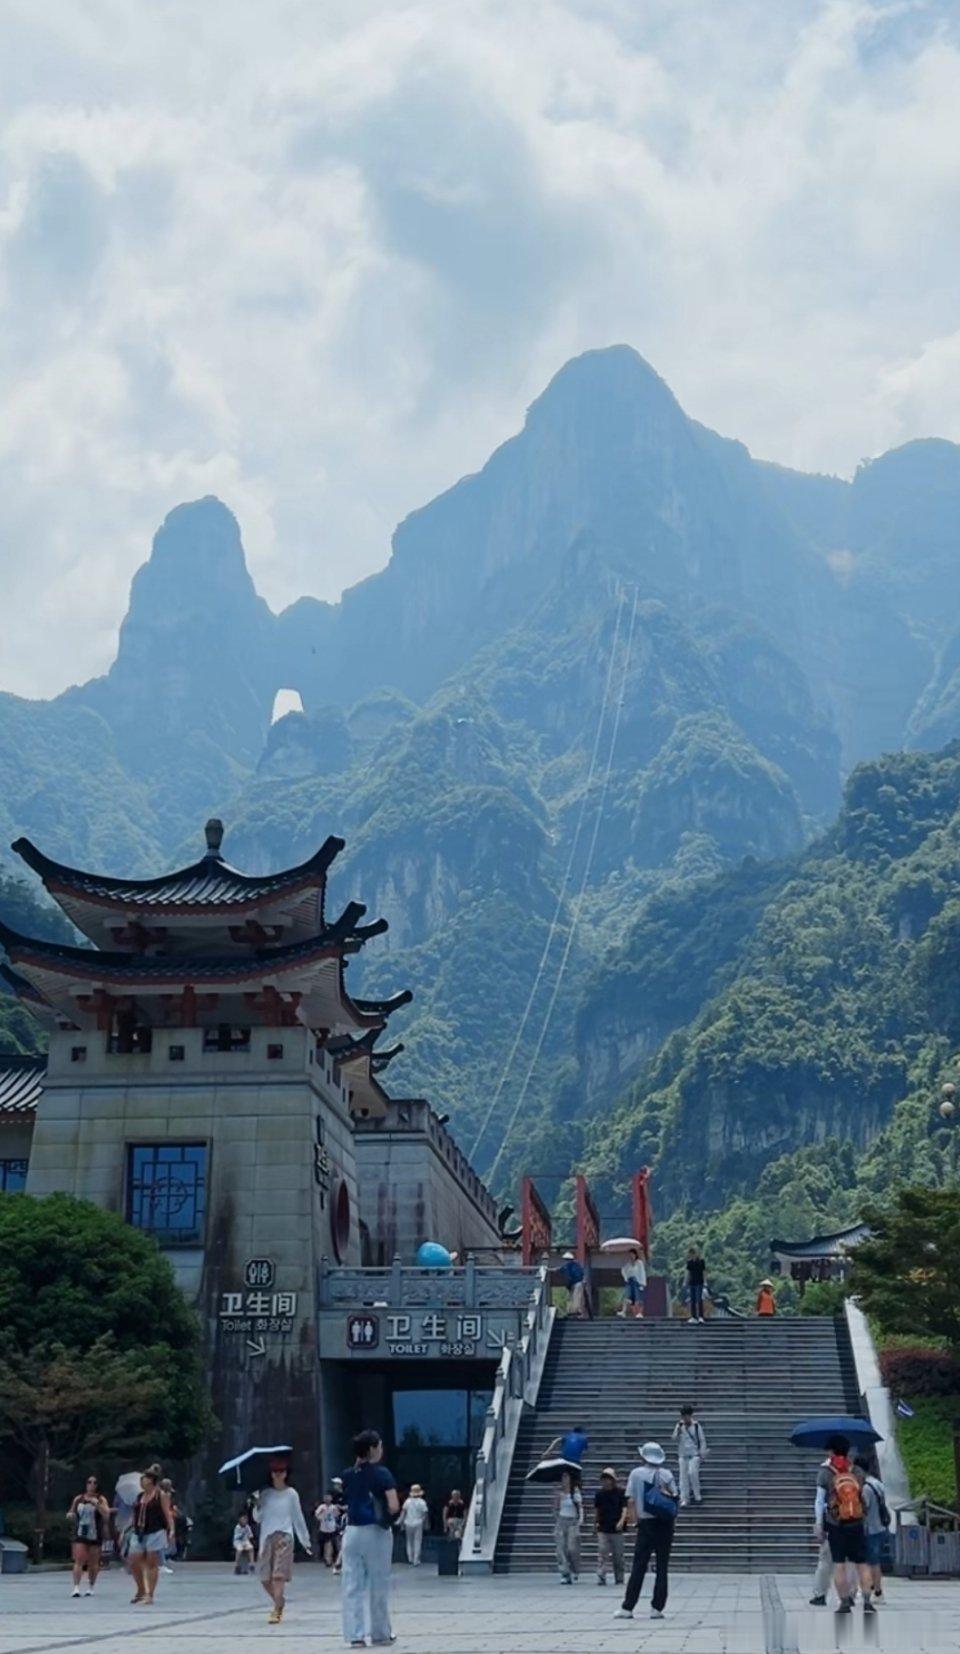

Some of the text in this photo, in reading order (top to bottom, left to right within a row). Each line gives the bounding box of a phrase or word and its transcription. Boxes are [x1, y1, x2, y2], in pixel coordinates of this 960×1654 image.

[219, 1292, 297, 1317] 卫生间
[385, 1314, 482, 1341] 卫生间
[389, 1343, 428, 1354] TOILET
